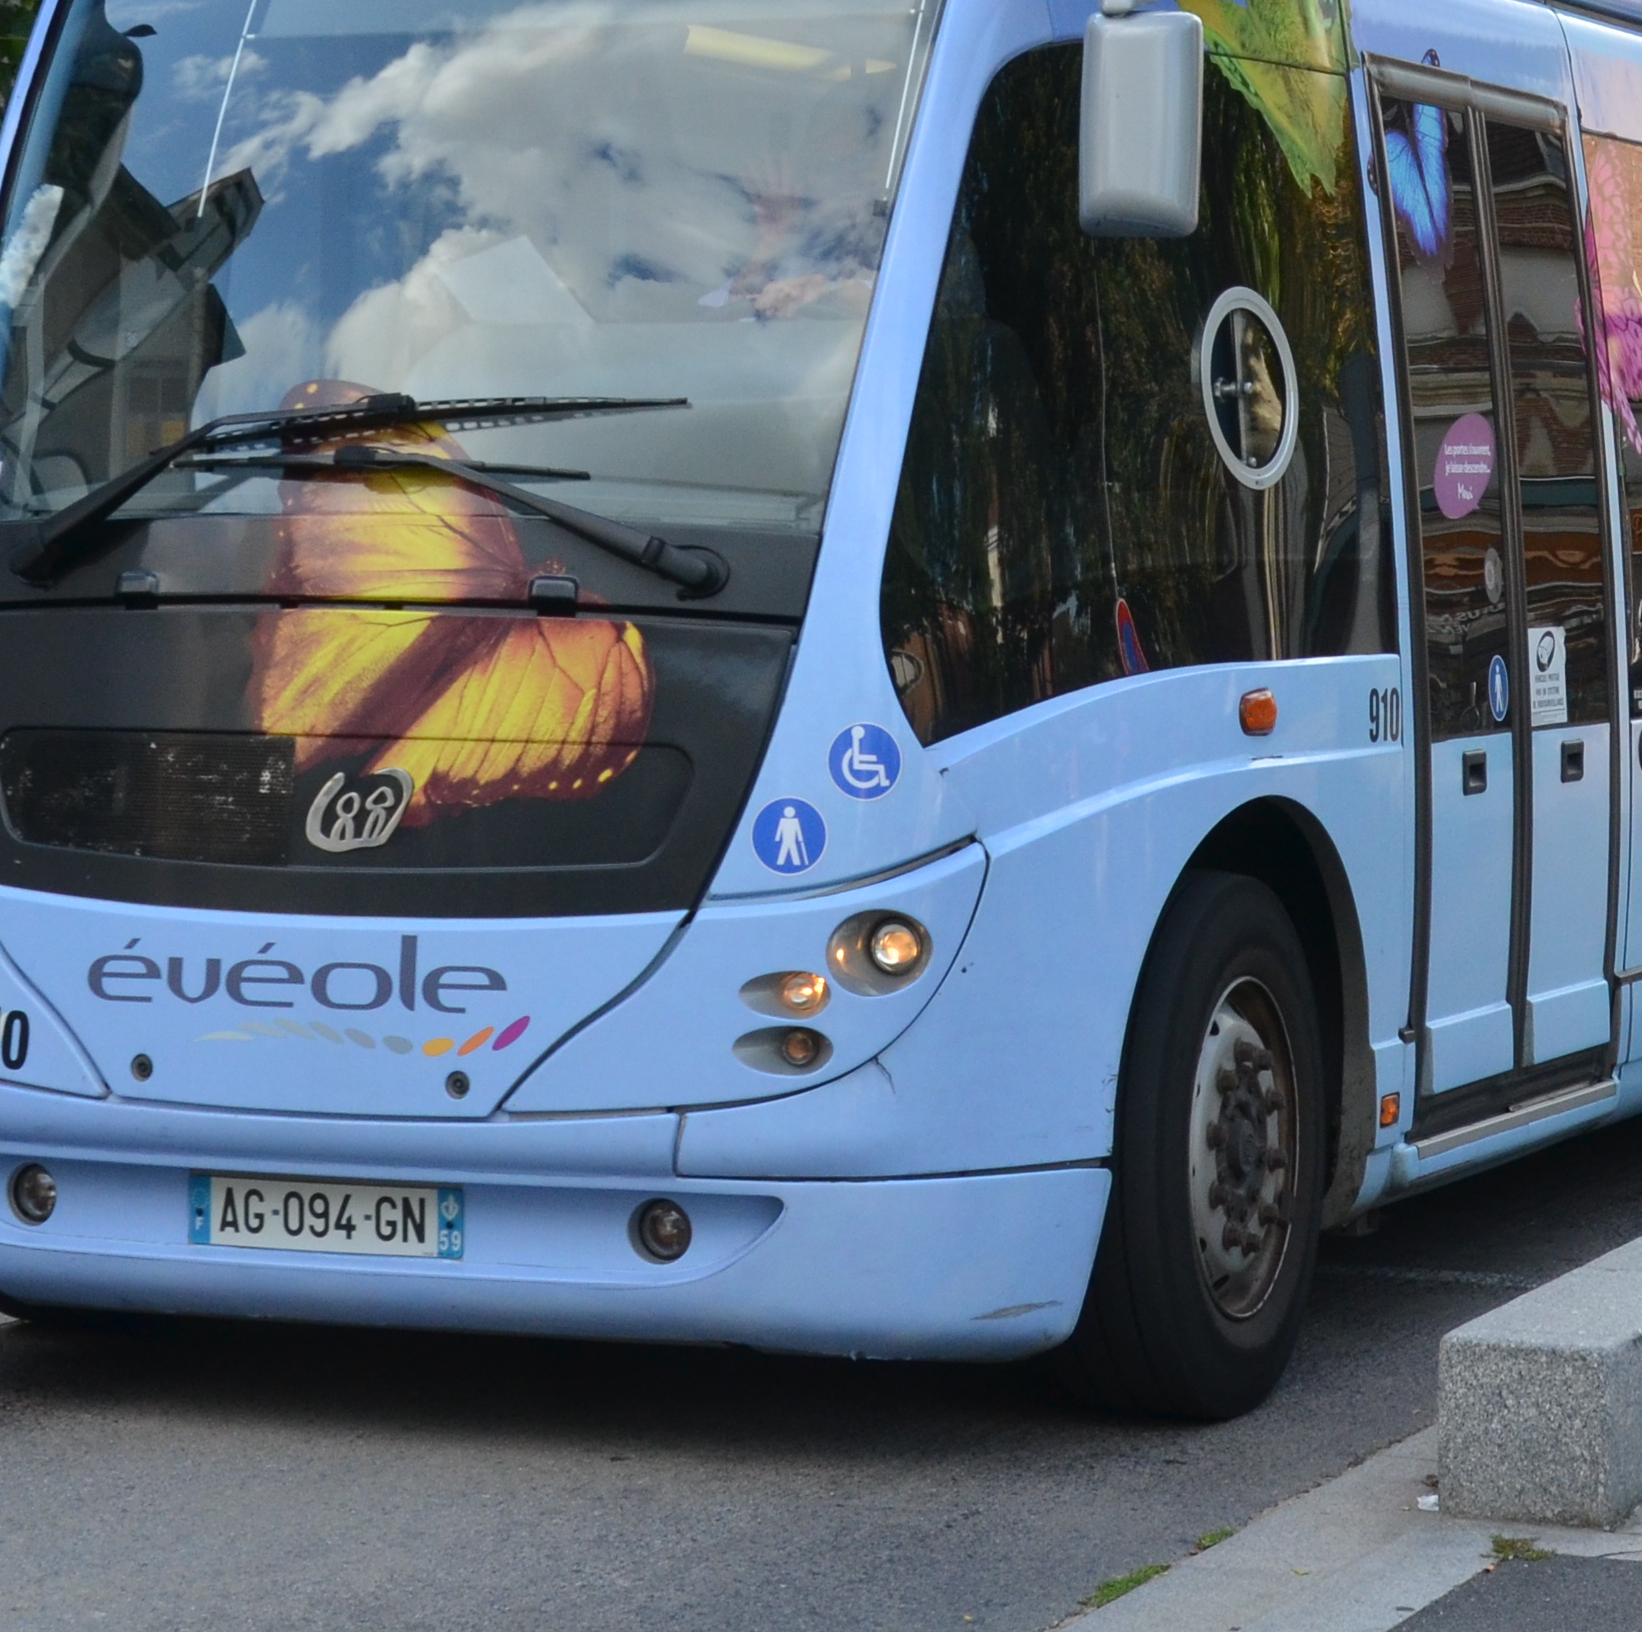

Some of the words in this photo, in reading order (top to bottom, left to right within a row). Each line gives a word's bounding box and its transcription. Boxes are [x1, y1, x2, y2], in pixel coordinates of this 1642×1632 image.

[1369, 687, 1400, 743] 910
[86, 934, 508, 1014] évéole
[194, 1216, 203, 1231] F
[219, 1186, 426, 1244] AG-094-GN
[438, 1229, 462, 1252] 59
